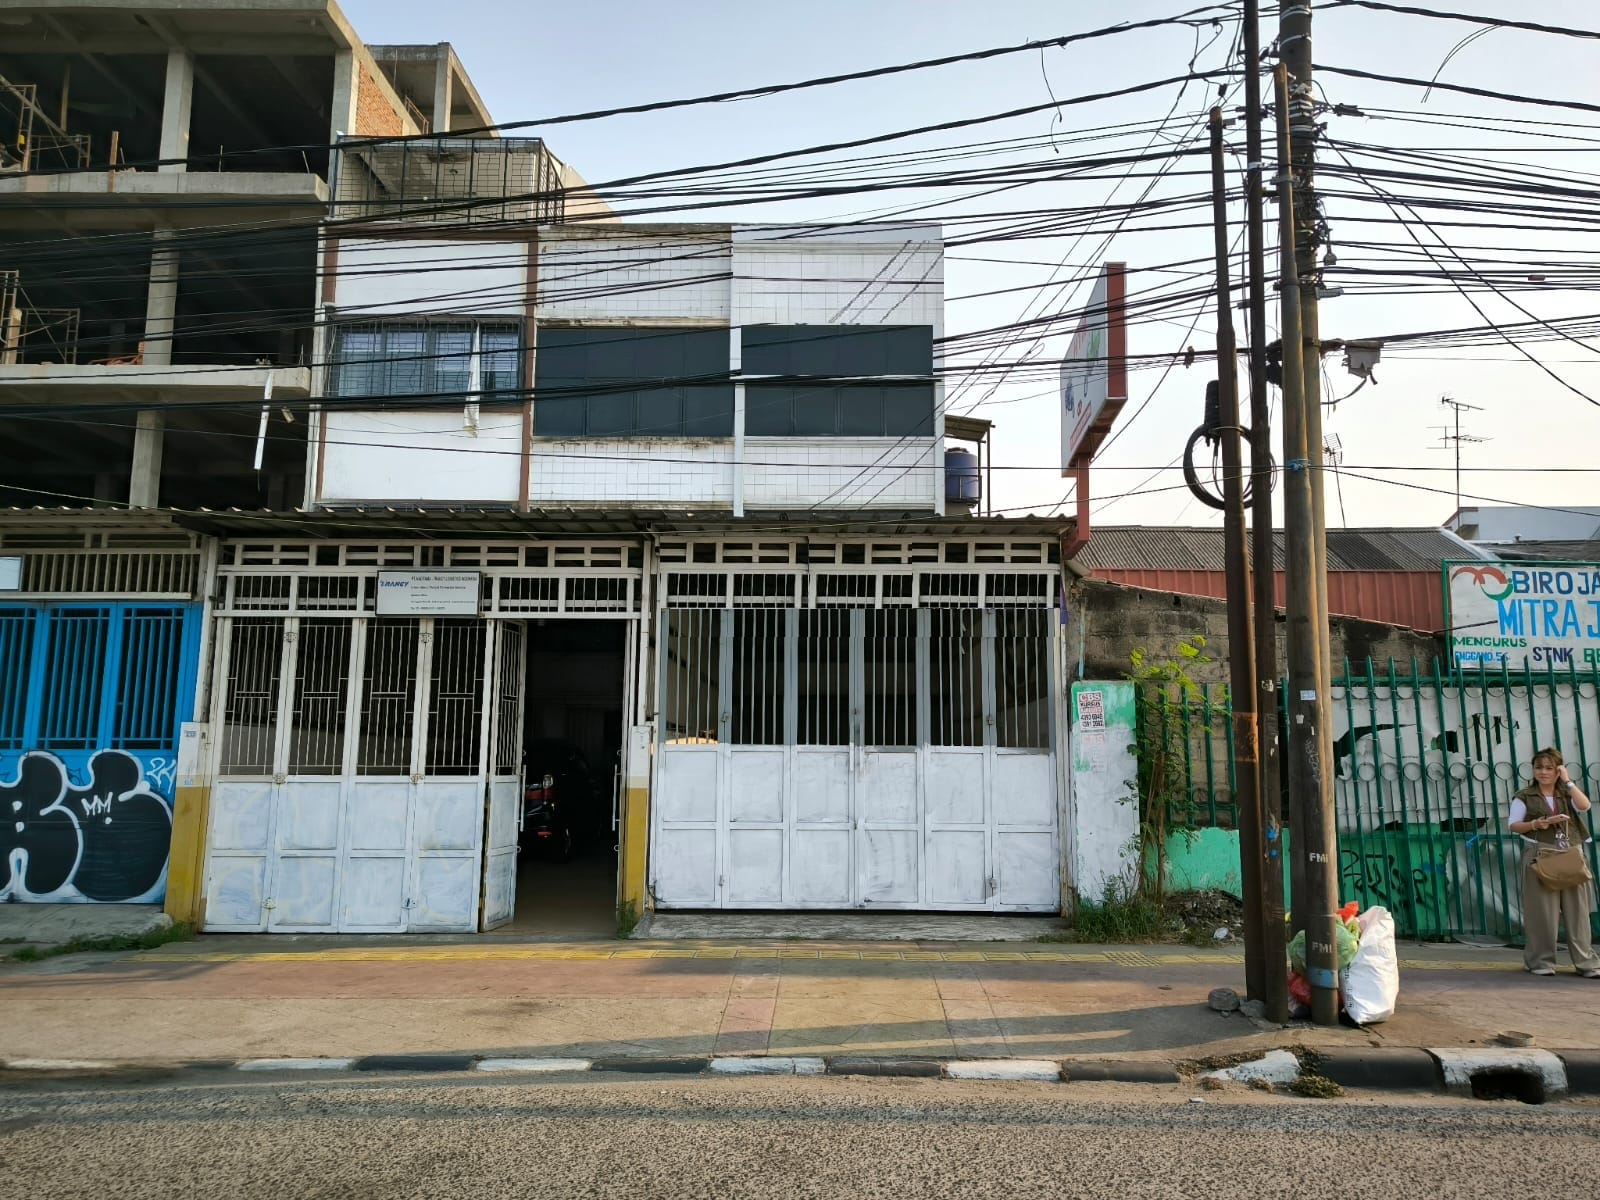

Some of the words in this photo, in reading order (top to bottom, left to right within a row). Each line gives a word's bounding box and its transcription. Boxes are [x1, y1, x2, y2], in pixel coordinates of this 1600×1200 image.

[1511, 571, 1573, 594] BIRO
[1498, 600, 1581, 637] MITRA
[1452, 636, 1527, 648] MENGURUS
[1532, 647, 1573, 663] STNK
[1081, 693, 1101, 701] CBS
